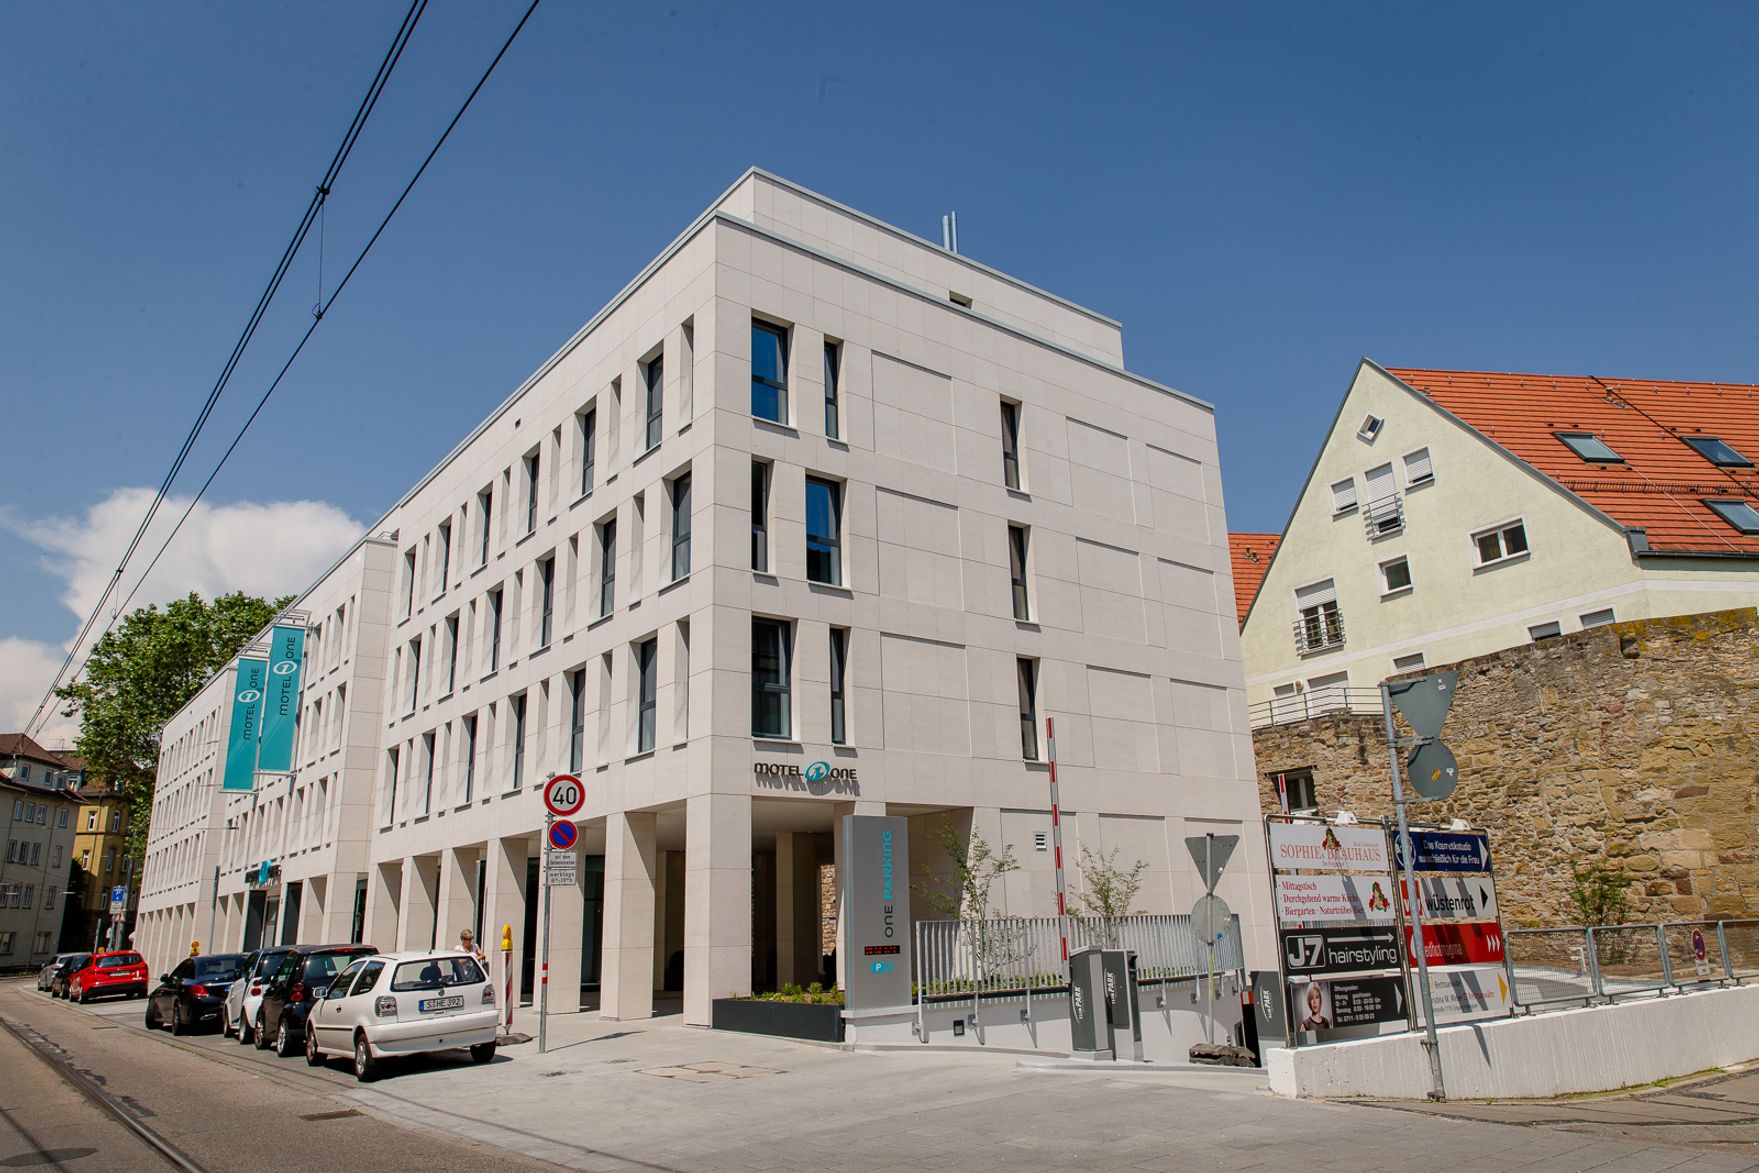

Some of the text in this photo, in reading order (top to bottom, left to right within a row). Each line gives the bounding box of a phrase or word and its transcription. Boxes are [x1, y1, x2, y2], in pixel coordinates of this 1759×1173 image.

[285, 636, 296, 659] ONE
[243, 703, 256, 740] MOTEL
[250, 667, 260, 689] ONE
[280, 676, 292, 716] MOTEL
[754, 762, 804, 777] MOTEL
[830, 768, 857, 780] ONE
[552, 786, 577, 805] 40
[1327, 847, 1381, 861] BRAUHAUS
[1469, 855, 1480, 865] Frau
[882, 830, 894, 938] ONE PARKING
[1283, 894, 1321, 904] Durchgehend
[1425, 894, 1474, 911] wüstenrot
[1285, 906, 1316, 917] Biergarten
[1328, 946, 1397, 965] hairstyling
